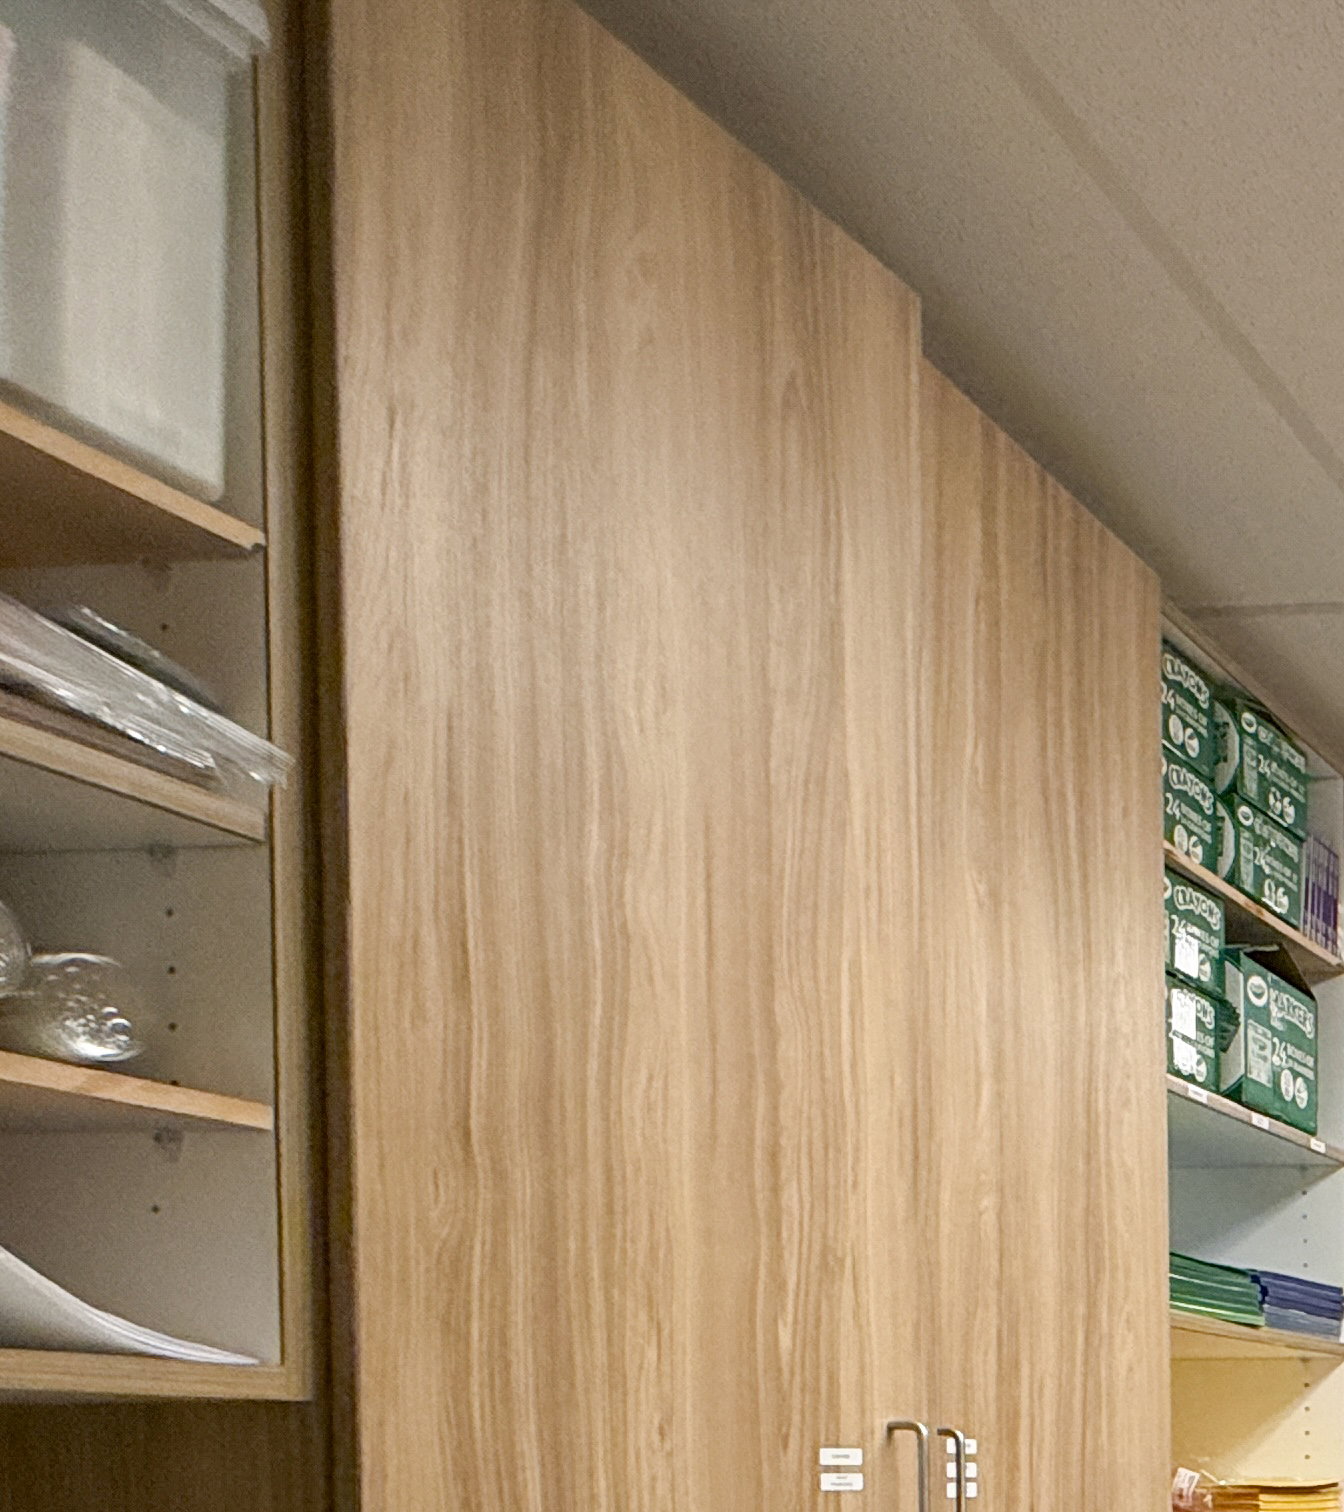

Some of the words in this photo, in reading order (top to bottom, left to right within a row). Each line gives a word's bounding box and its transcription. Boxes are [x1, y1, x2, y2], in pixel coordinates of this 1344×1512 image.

[1165, 792, 1181, 819] 24
[1168, 764, 1214, 815] CRAYONS
[1173, 885, 1222, 930] CRAYONS
[1269, 986, 1315, 1039] MARKERS
[1272, 1036, 1287, 1067] 24
